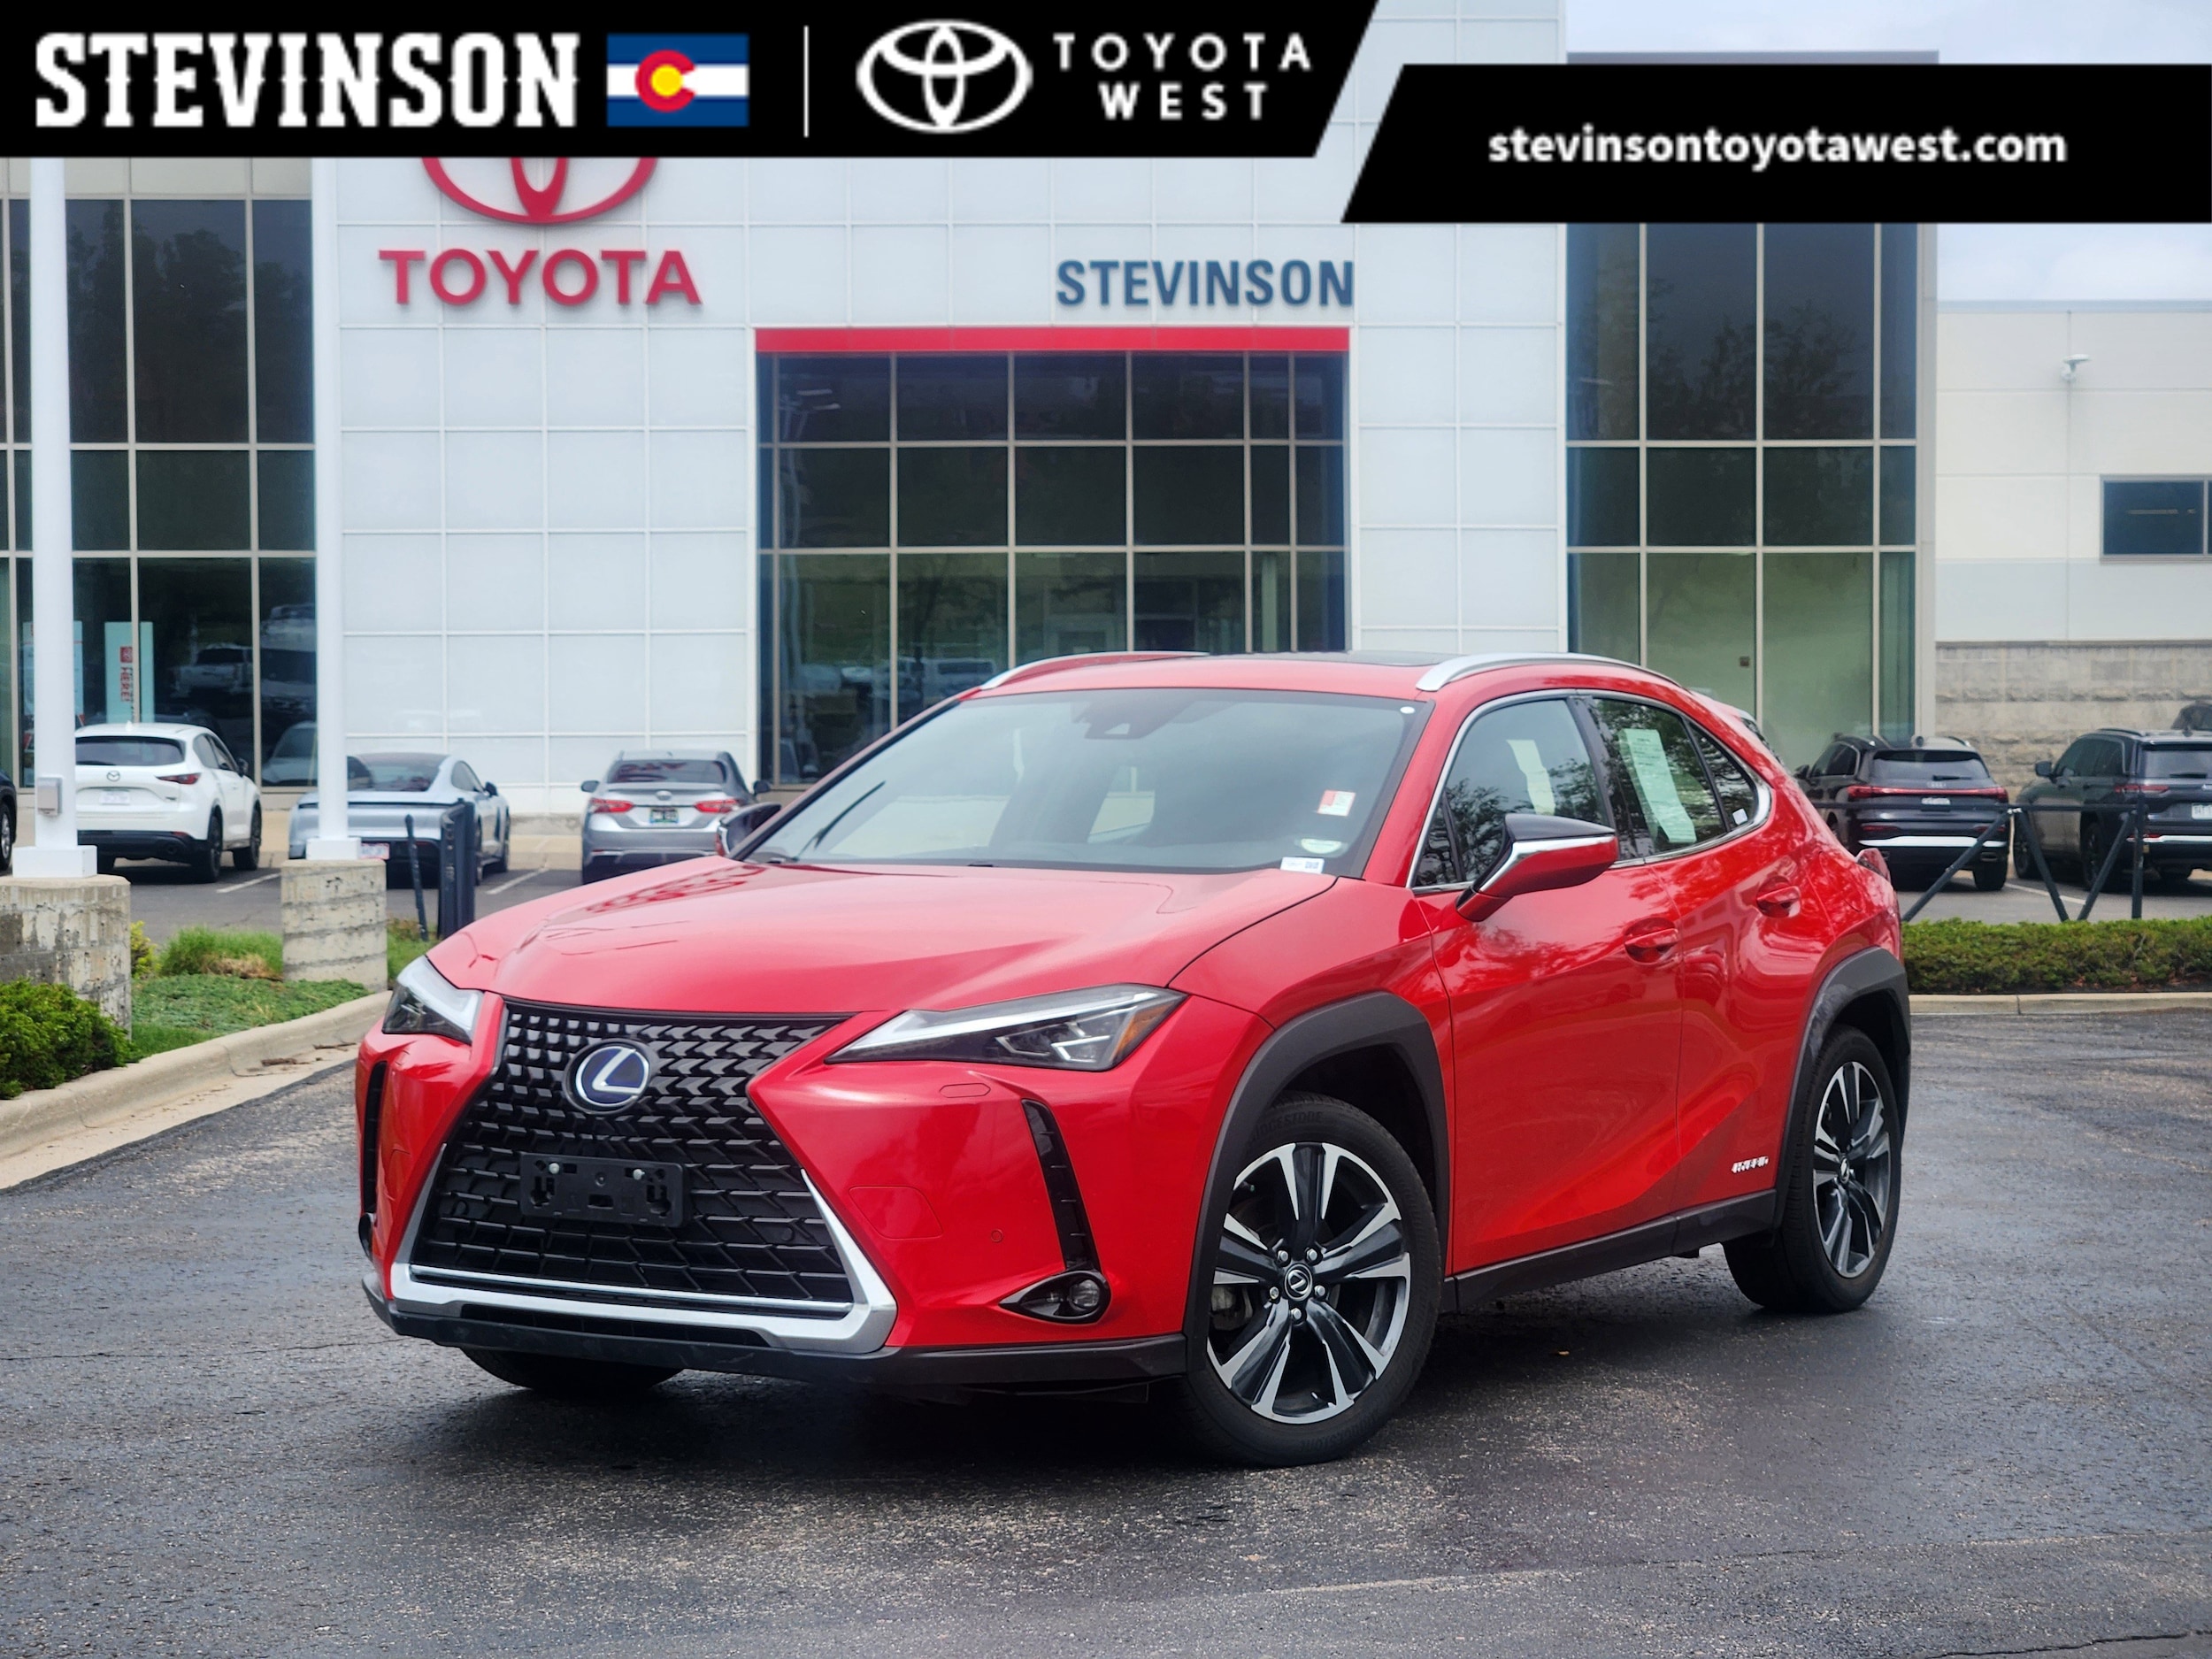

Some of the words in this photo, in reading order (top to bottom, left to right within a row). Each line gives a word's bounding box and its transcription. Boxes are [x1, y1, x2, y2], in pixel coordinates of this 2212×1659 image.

[378, 248, 703, 305] TOYOTA
[1056, 259, 1354, 307] STEVINSON
[1253, 1110, 1325, 1141] IDGESTONE
